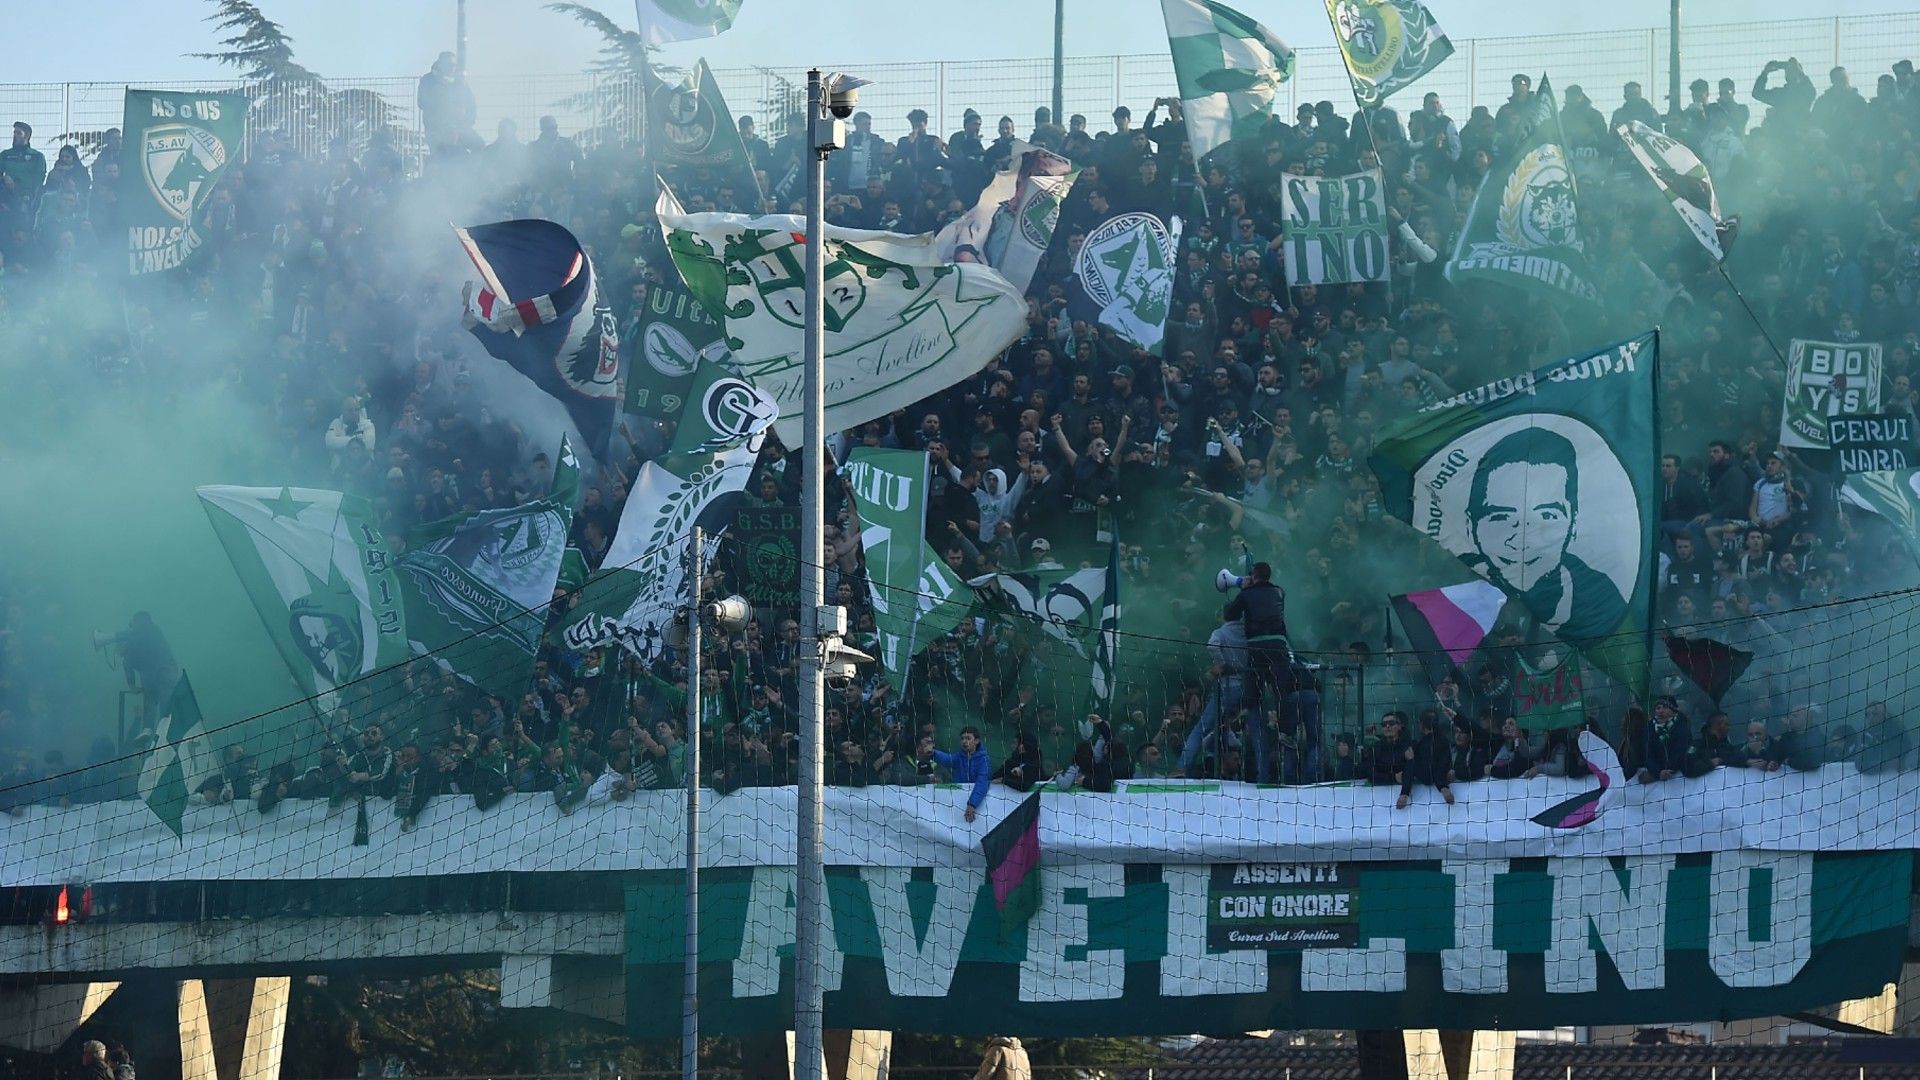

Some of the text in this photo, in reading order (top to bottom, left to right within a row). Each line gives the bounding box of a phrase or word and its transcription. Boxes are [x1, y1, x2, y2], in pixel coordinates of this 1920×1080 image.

[151, 97, 177, 118] AS
[195, 99, 221, 121] US
[1287, 175, 1380, 229] SER
[1290, 228, 1386, 285] INO
[1232, 863, 1338, 885] ASSENTI
[1219, 893, 1350, 918] CON ONORE
[1228, 929, 1340, 943] Curva Sud Avellino
